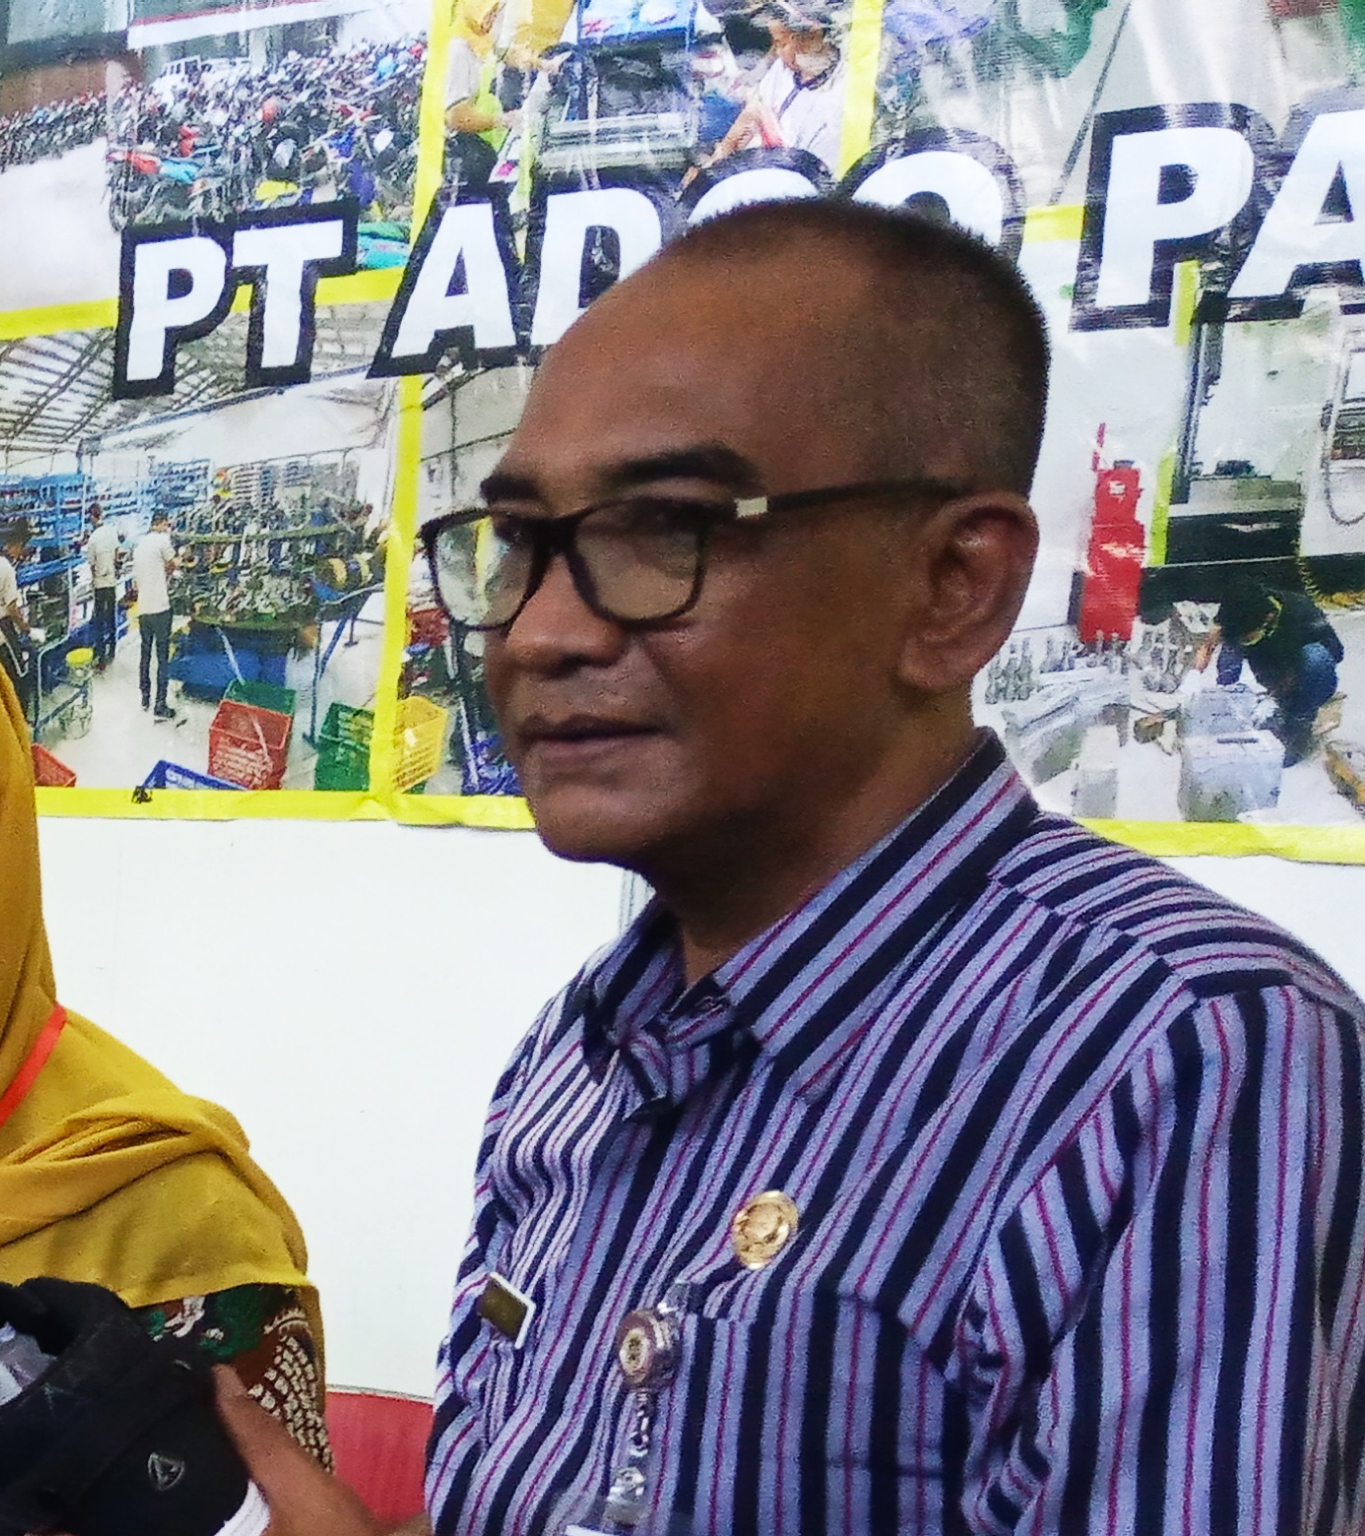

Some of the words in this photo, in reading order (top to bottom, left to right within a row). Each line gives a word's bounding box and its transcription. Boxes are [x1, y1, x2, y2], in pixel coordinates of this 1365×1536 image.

[117, 207, 353, 392] PT
[376, 144, 1017, 370] AD
[1084, 103, 1365, 318] PA
